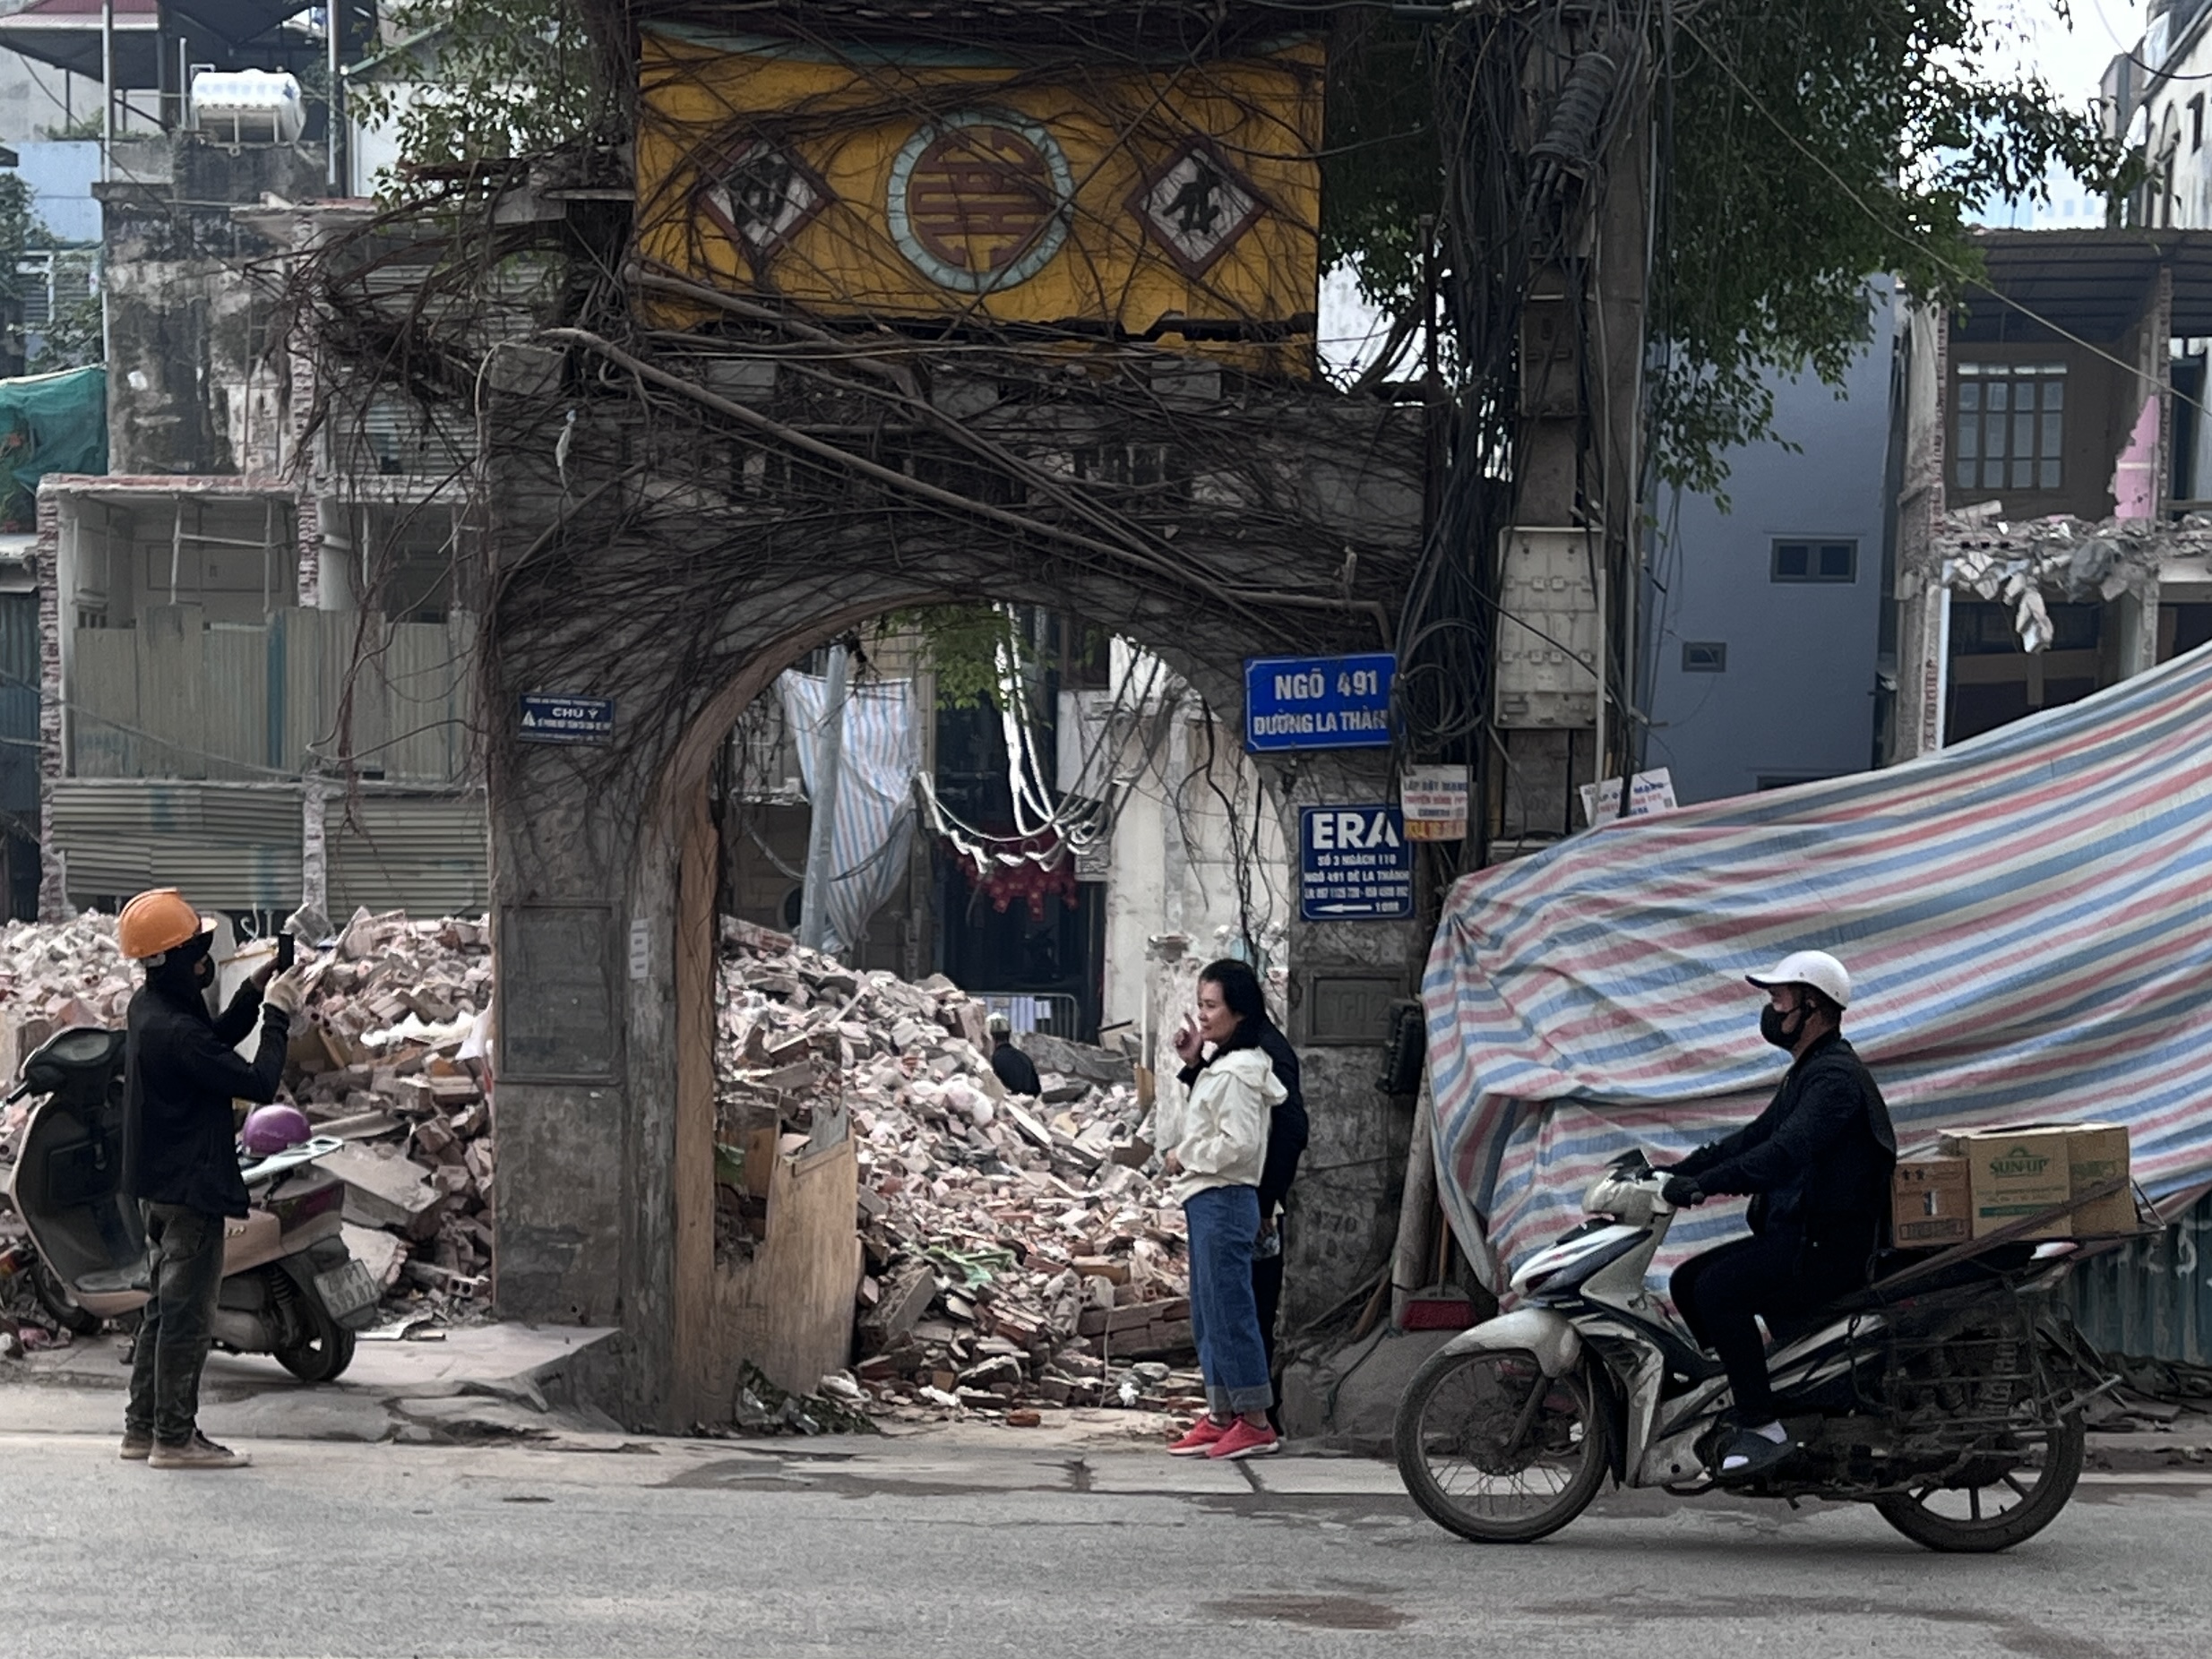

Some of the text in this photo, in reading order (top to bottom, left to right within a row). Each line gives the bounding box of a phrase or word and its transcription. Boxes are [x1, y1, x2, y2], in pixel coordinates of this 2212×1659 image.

[1275, 667, 1378, 701] NGÕ 491
[552, 706, 598, 719] CHÚ Ý
[1316, 712, 1338, 733] LA
[1313, 812, 1399, 849] ERA
[1333, 855, 1339, 866] 3
[1378, 854, 1397, 865] 110
[1327, 871, 1345, 883] 491
[1362, 871, 1375, 882] LA
